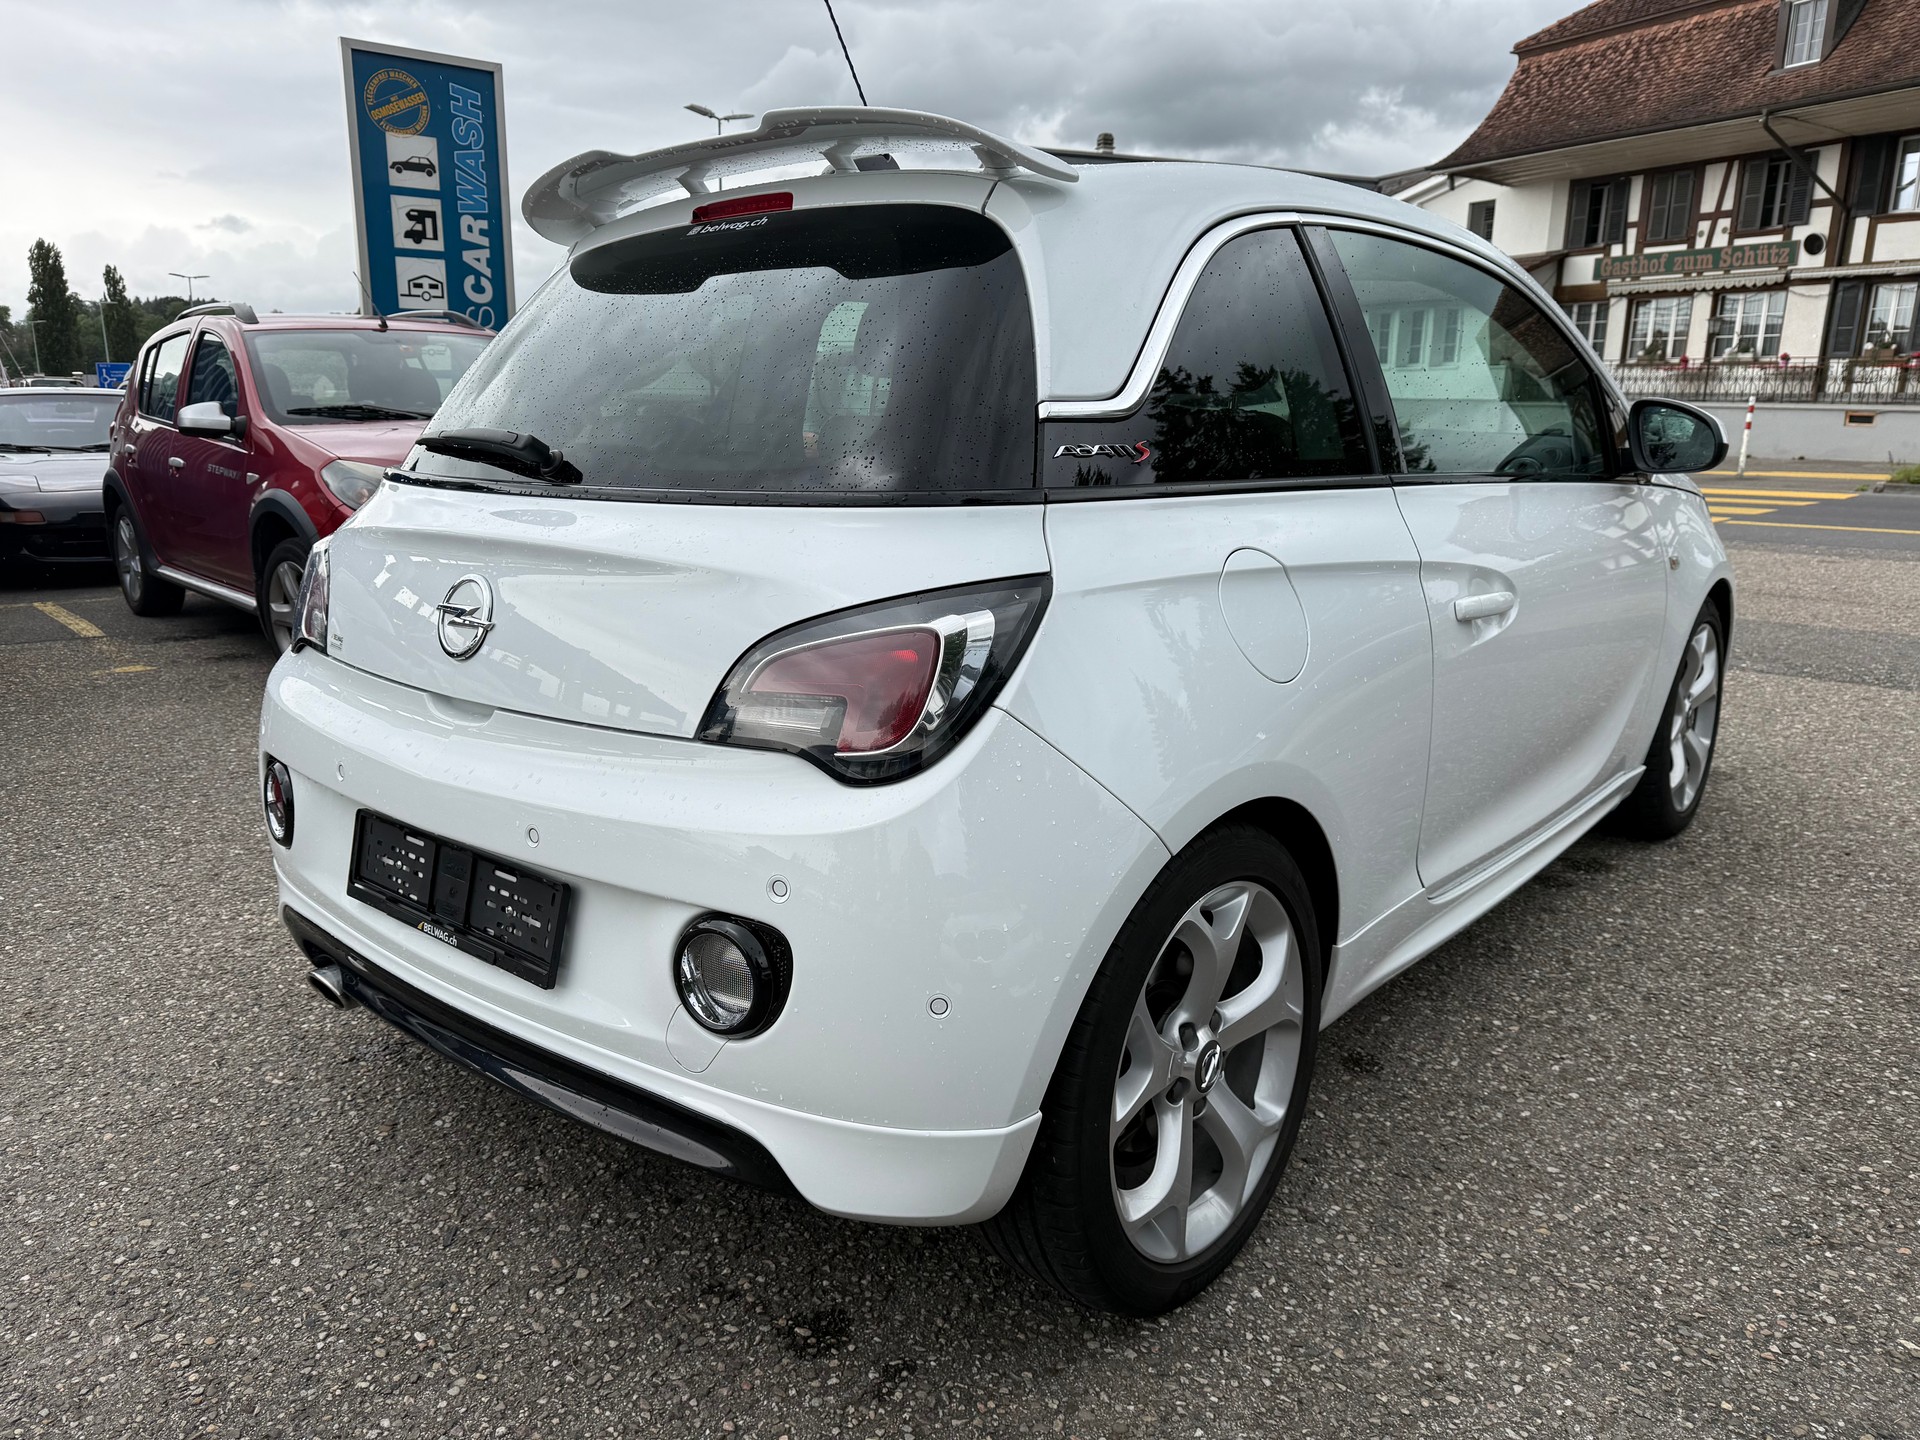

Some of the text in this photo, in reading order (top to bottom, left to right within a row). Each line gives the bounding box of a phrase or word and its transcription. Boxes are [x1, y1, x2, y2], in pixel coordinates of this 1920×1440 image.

[371, 91, 426, 120] OSMOSEWASSER
[700, 216, 769, 234] belwag.ch
[1600, 244, 1791, 277] Gasthof zum Schütz
[1053, 440, 1151, 464] ADAM S
[423, 922, 458, 947] BELWAG.ch
